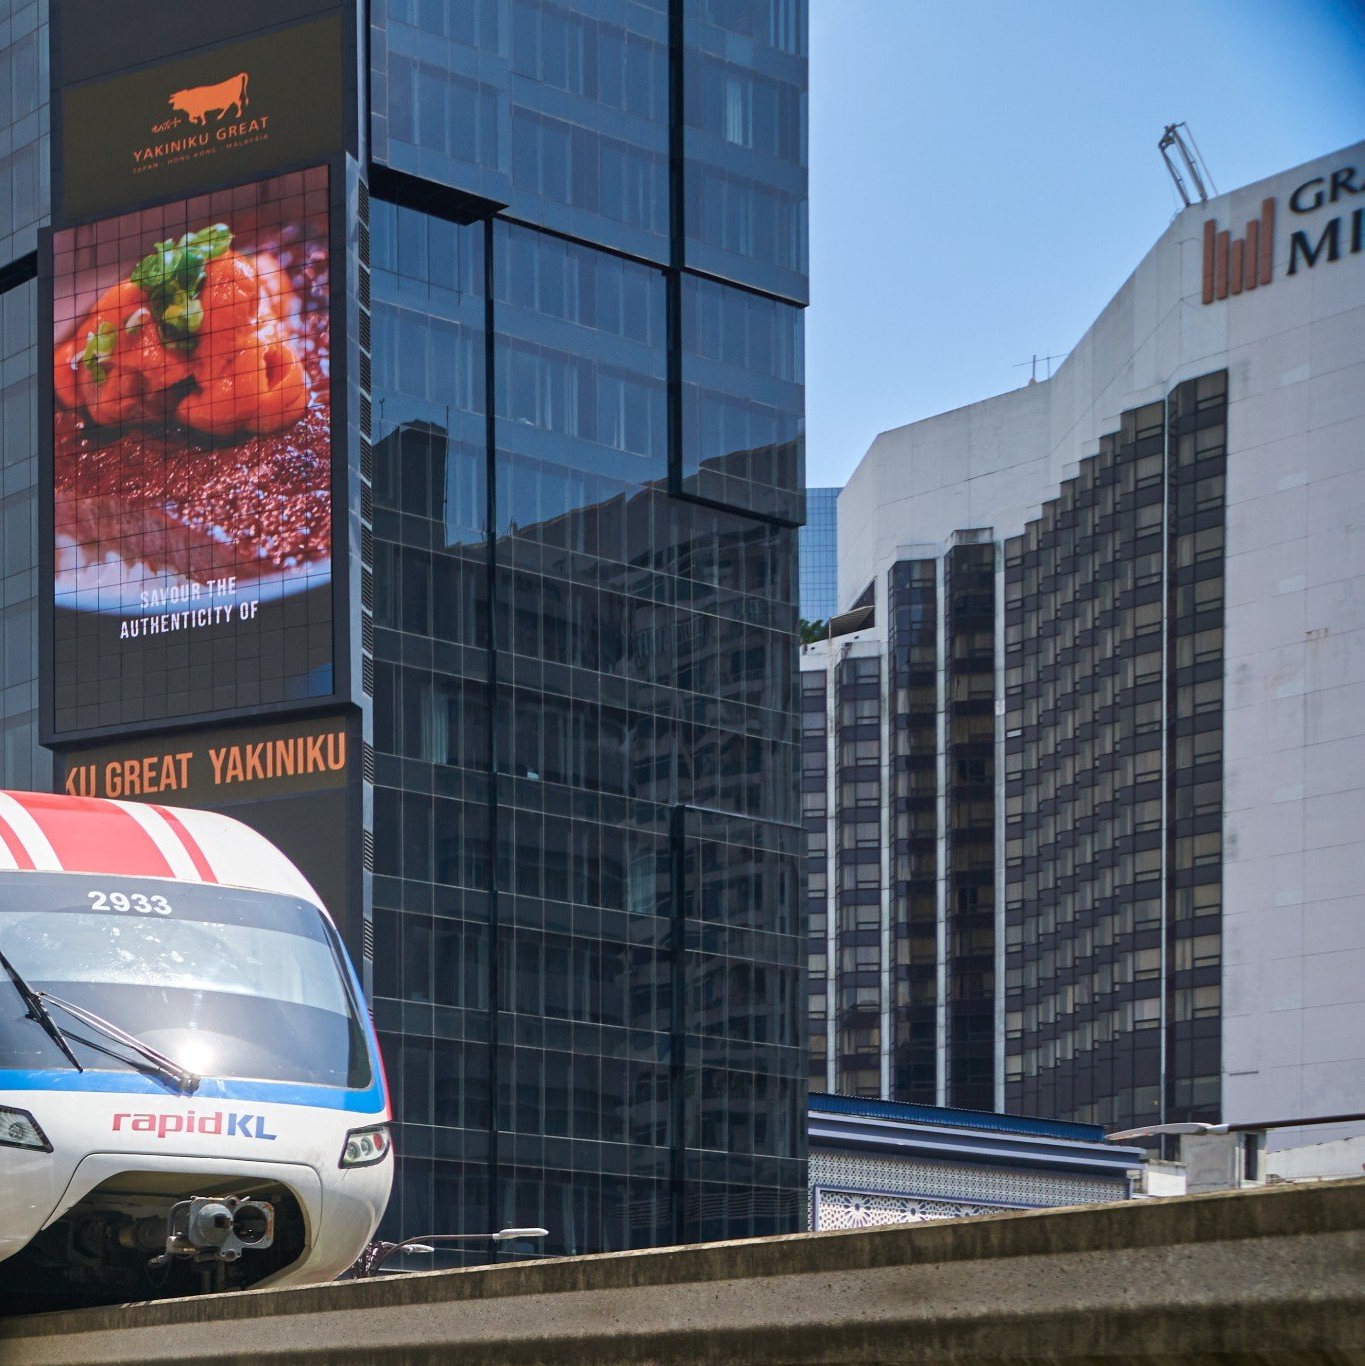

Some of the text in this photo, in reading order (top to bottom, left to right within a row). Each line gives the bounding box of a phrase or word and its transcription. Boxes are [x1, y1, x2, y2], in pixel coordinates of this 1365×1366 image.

[132, 132, 209, 163] YAKINIKU
[216, 115, 269, 142] GREAT
[1289, 166, 1365, 214] GR
[140, 576, 237, 609] SAVOUR THE
[119, 600, 259, 640] AUTHENTICITY OF
[105, 752, 193, 799] GREAT
[208, 731, 347, 785] YAKINIKU
[87, 890, 173, 915] 2933
[112, 1110, 278, 1141] rapidKL
